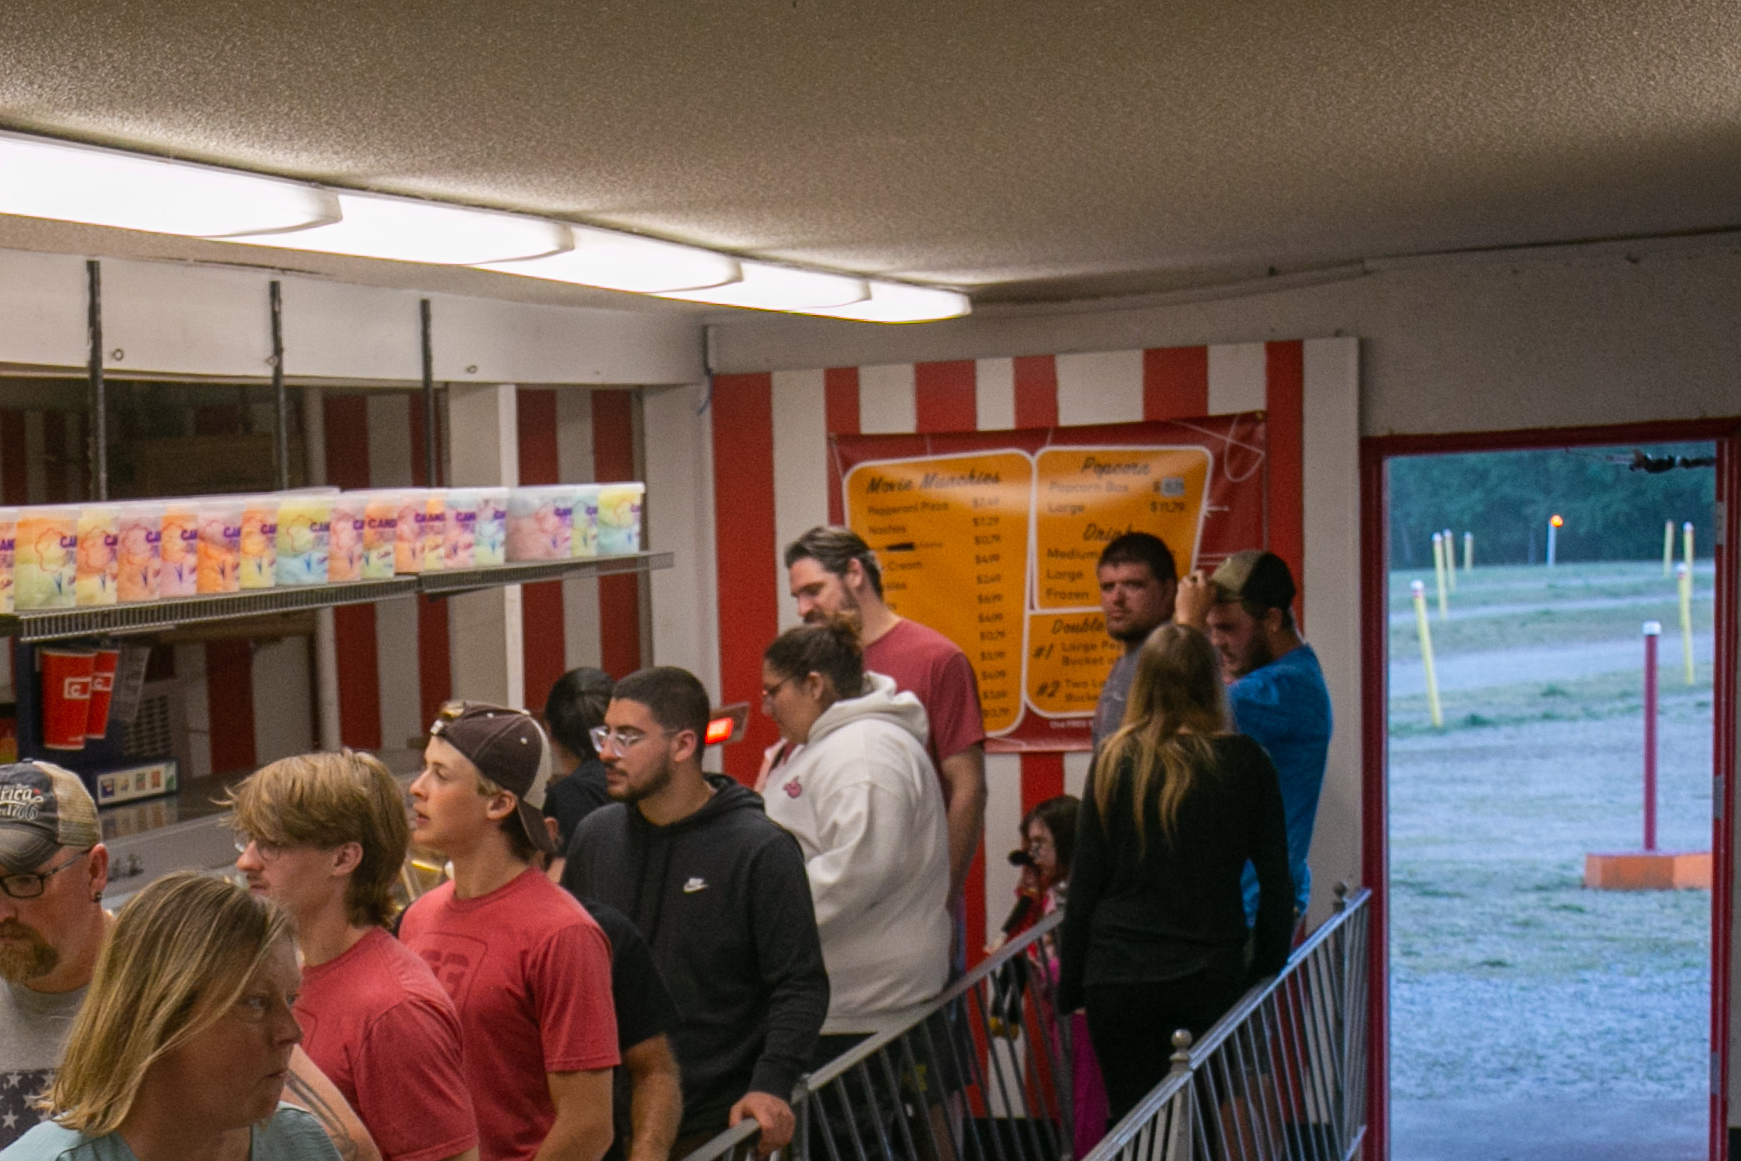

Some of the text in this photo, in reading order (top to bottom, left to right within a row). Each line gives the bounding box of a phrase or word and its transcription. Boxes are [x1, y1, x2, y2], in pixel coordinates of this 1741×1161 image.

[1081, 456, 1149, 477] Popcorn
[867, 468, 1000, 493] Movie Munchies
[1052, 618, 1105, 634] Double
